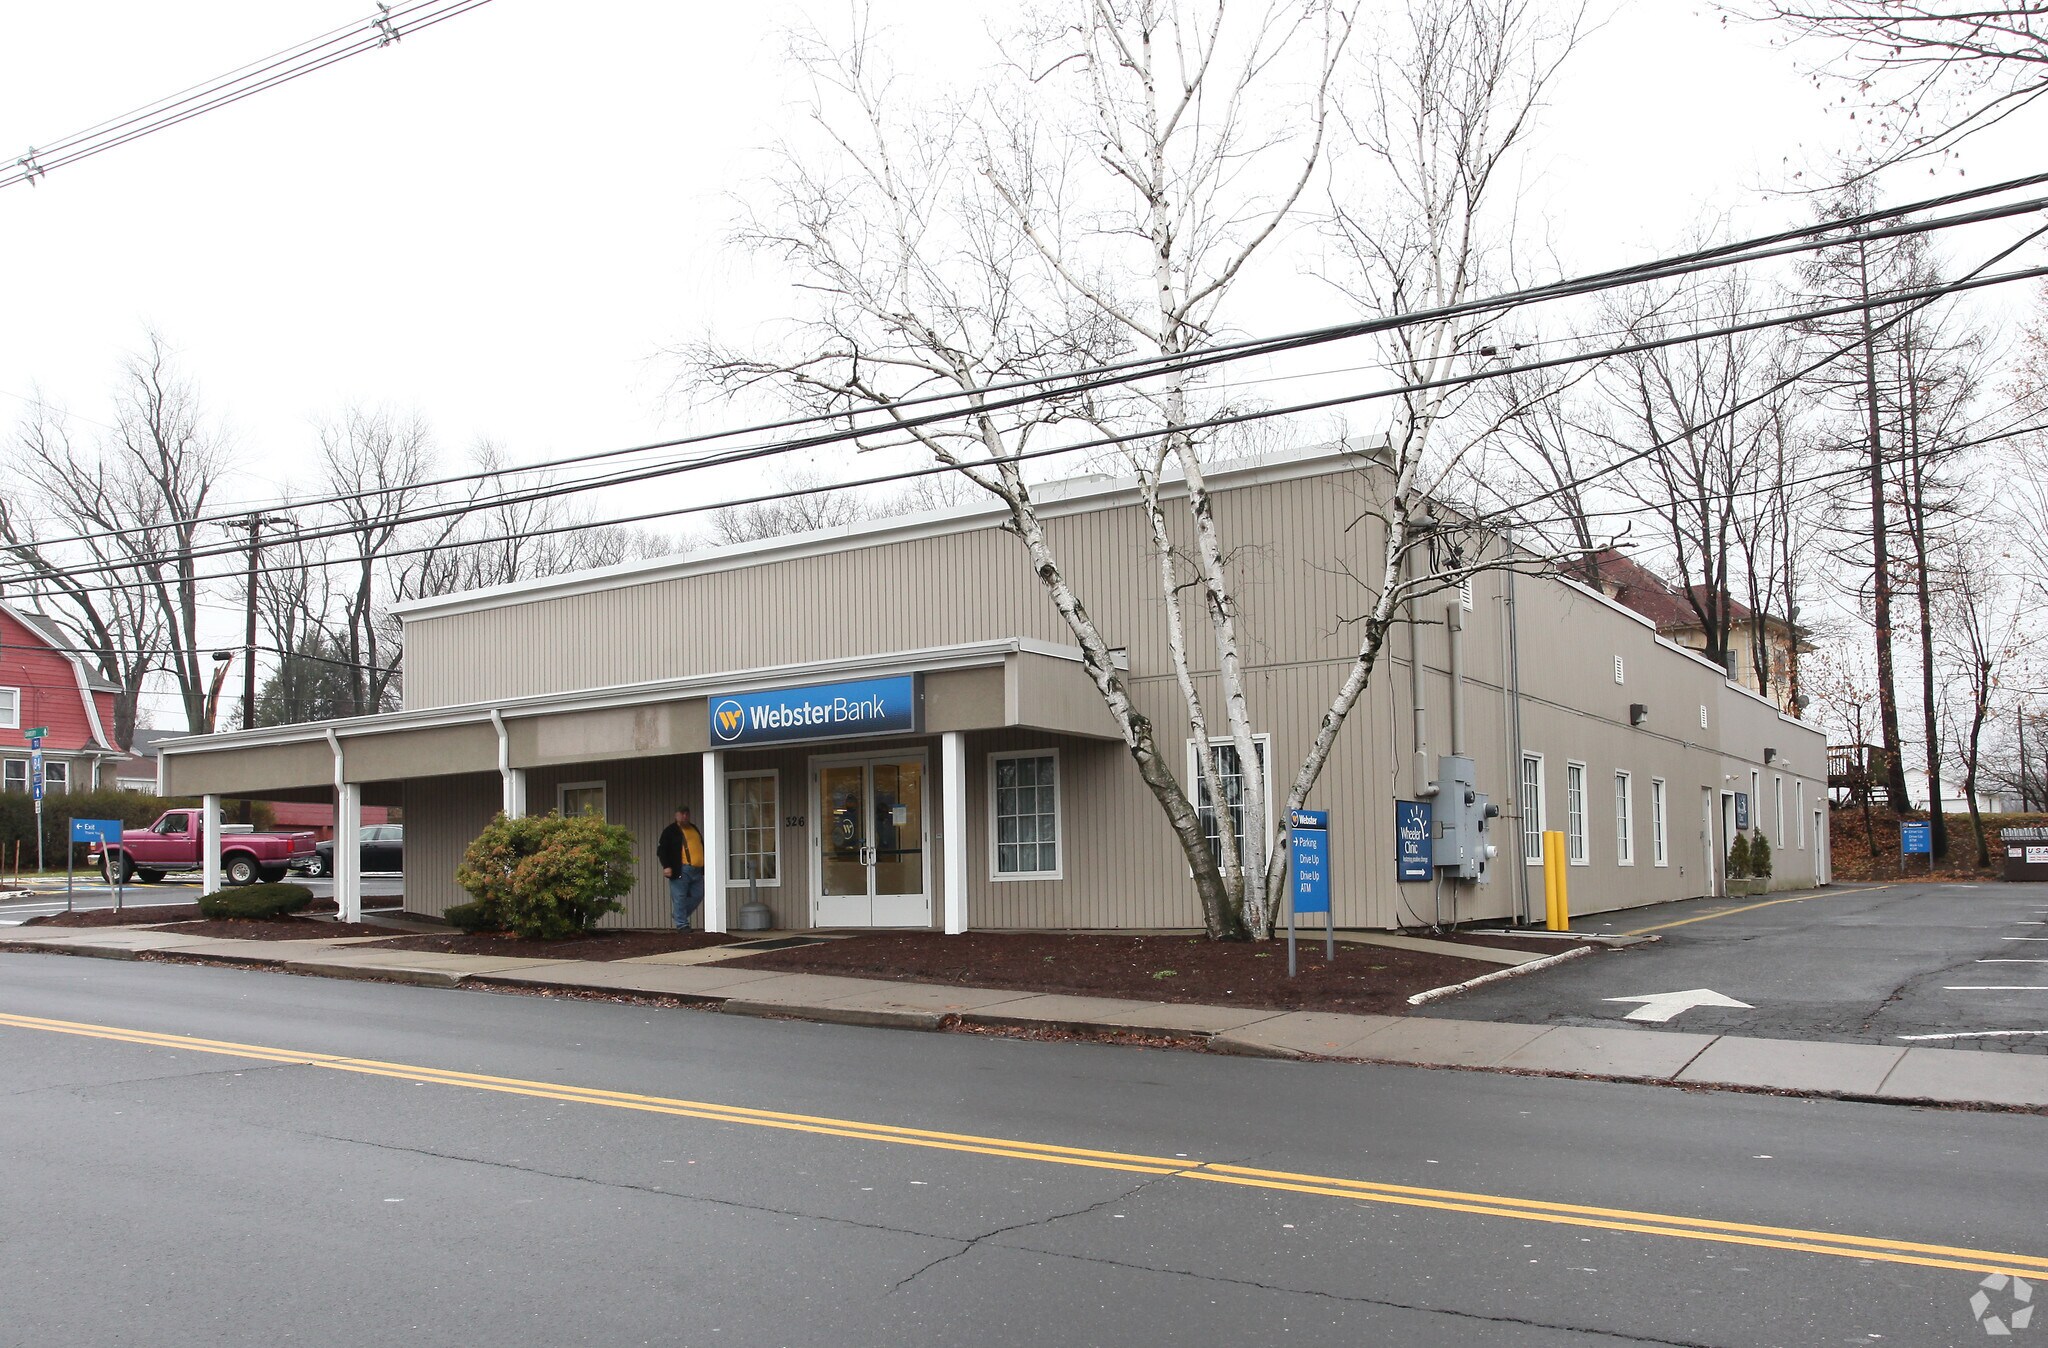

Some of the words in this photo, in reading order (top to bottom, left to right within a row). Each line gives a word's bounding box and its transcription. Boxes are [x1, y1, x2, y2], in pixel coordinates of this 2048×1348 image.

[785, 816, 805, 827] 326
[1299, 814, 1317, 825] Webster
[84, 823, 95, 831] Exit
[1400, 826, 1421, 840] Wheeler
[1299, 837, 1317, 849] Parking
[1404, 841, 1418, 854] Clinic
[1300, 854, 1311, 863] Drive
[1311, 854, 1320, 866] Up
[1300, 870, 1311, 881] Drive
[1312, 870, 1320, 882] Up
[1300, 882, 1311, 893] ATM
